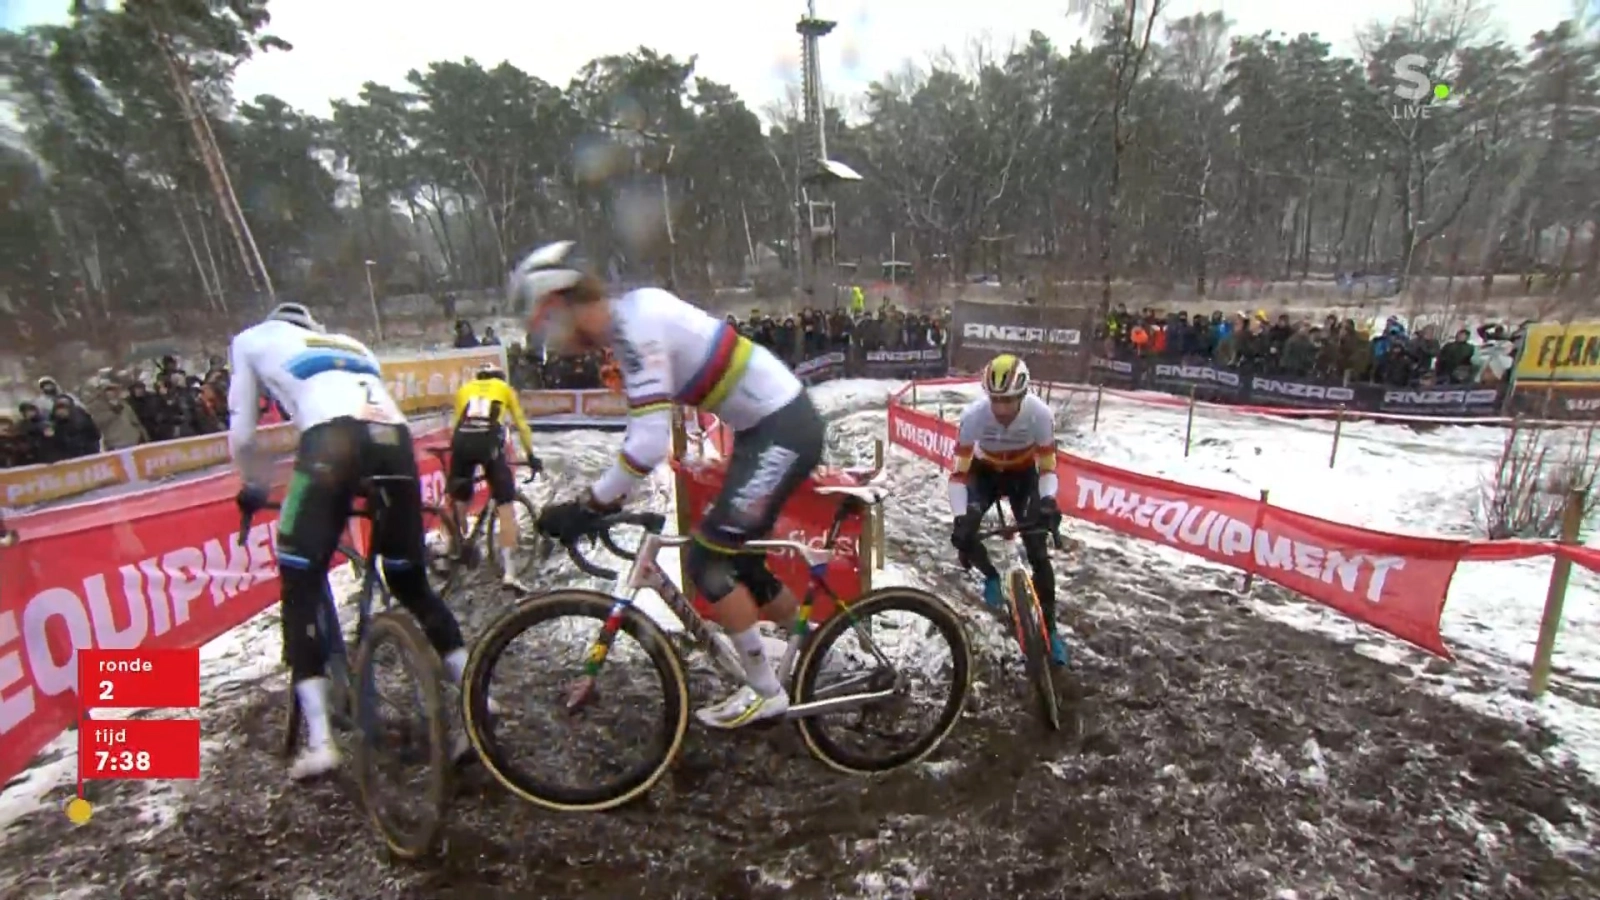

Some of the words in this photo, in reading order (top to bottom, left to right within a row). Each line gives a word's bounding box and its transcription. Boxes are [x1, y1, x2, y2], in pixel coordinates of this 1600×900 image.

[963, 323, 1044, 342] ANZA
[1155, 364, 1216, 381] ANZA
[1252, 377, 1326, 400] ANZA
